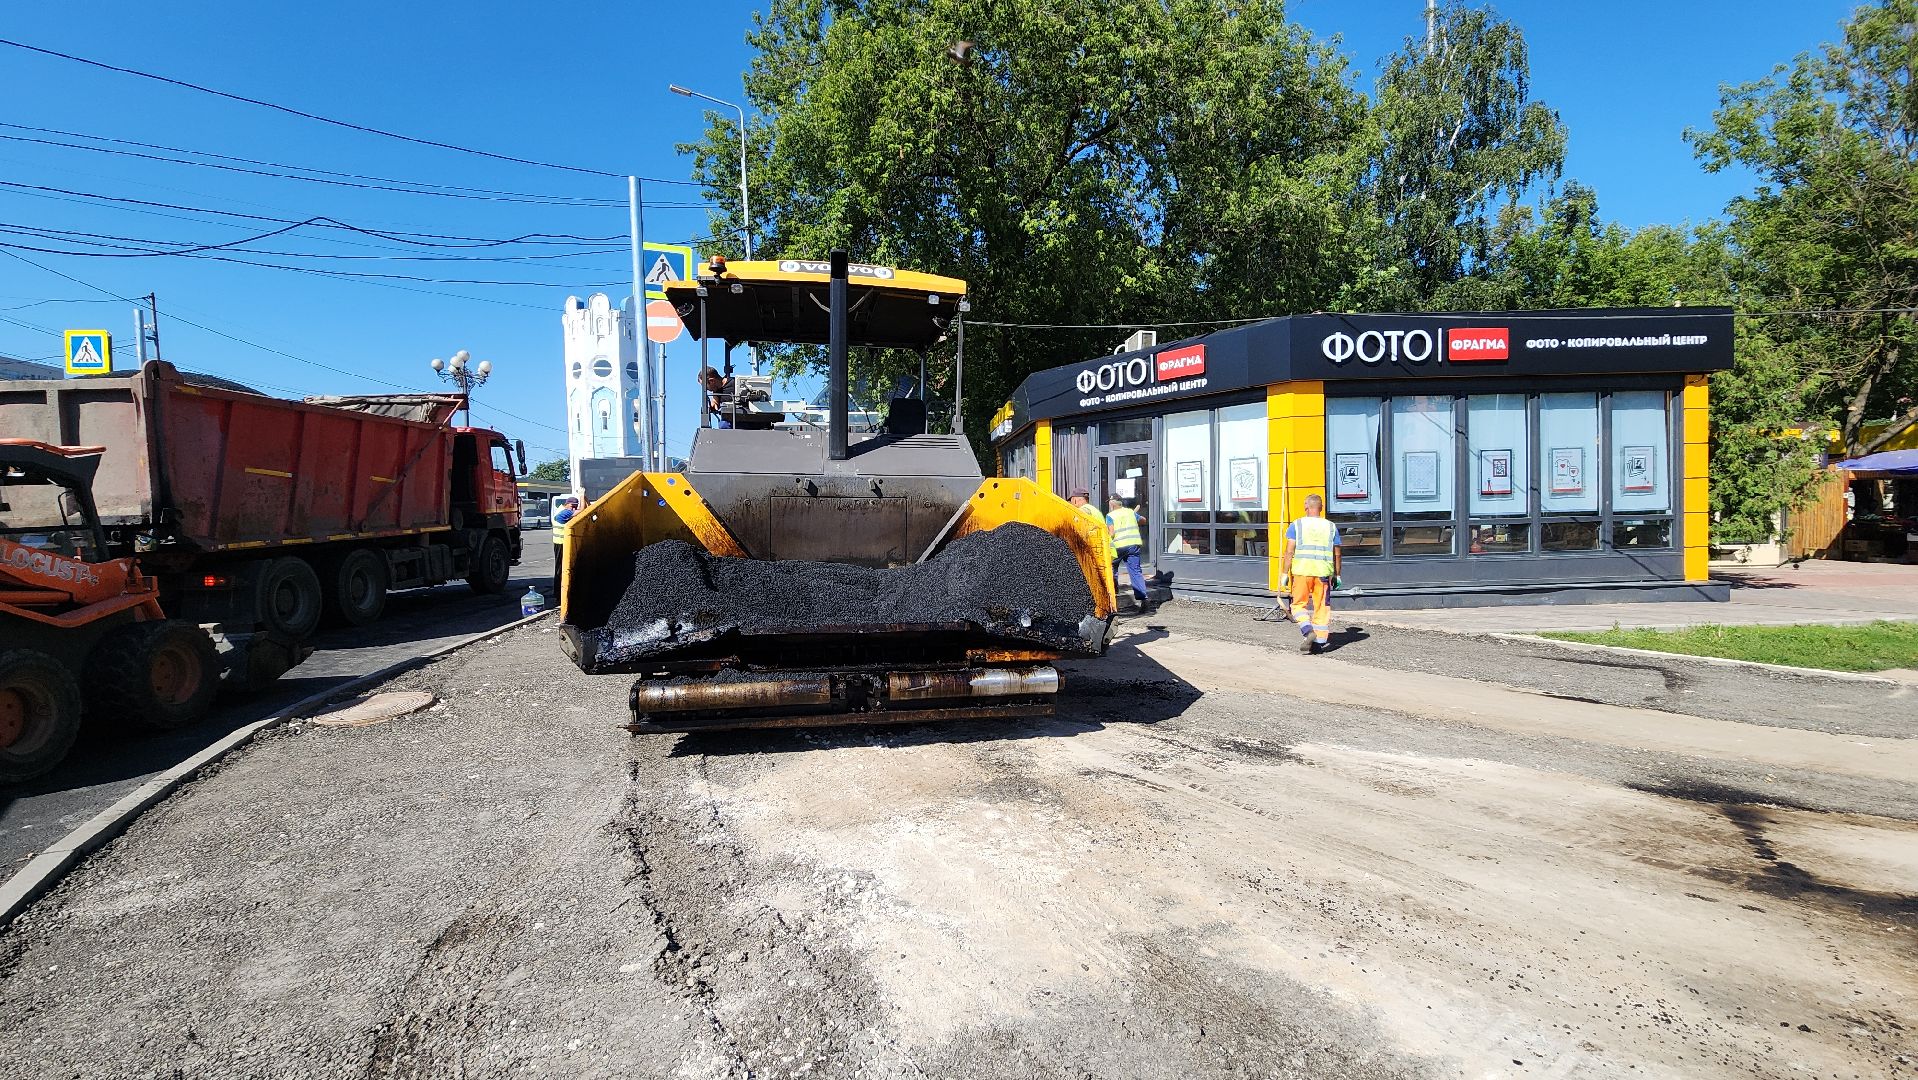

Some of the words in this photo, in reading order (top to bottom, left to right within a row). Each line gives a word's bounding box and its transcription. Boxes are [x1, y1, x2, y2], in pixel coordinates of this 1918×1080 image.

[801, 262, 874, 274] VOVO
[1322, 329, 1433, 362] ФОТО
[1451, 338, 1506, 350] ФРАГМА
[1526, 338, 1559, 349] ФОТО
[1567, 333, 1671, 348] КОПИРОВАЛЬНЫЙ
[1672, 335, 1708, 346] ЦЕНТР
[1076, 357, 1147, 394] ФОТО
[1159, 354, 1202, 371] ФРАГМА
[1079, 397, 1101, 408] ФОТО
[1105, 382, 1178, 403] КОПИРОВАЛЬНЫЙ
[1179, 378, 1208, 391] ЦЕНТР
[0, 543, 90, 584] LOCUST
